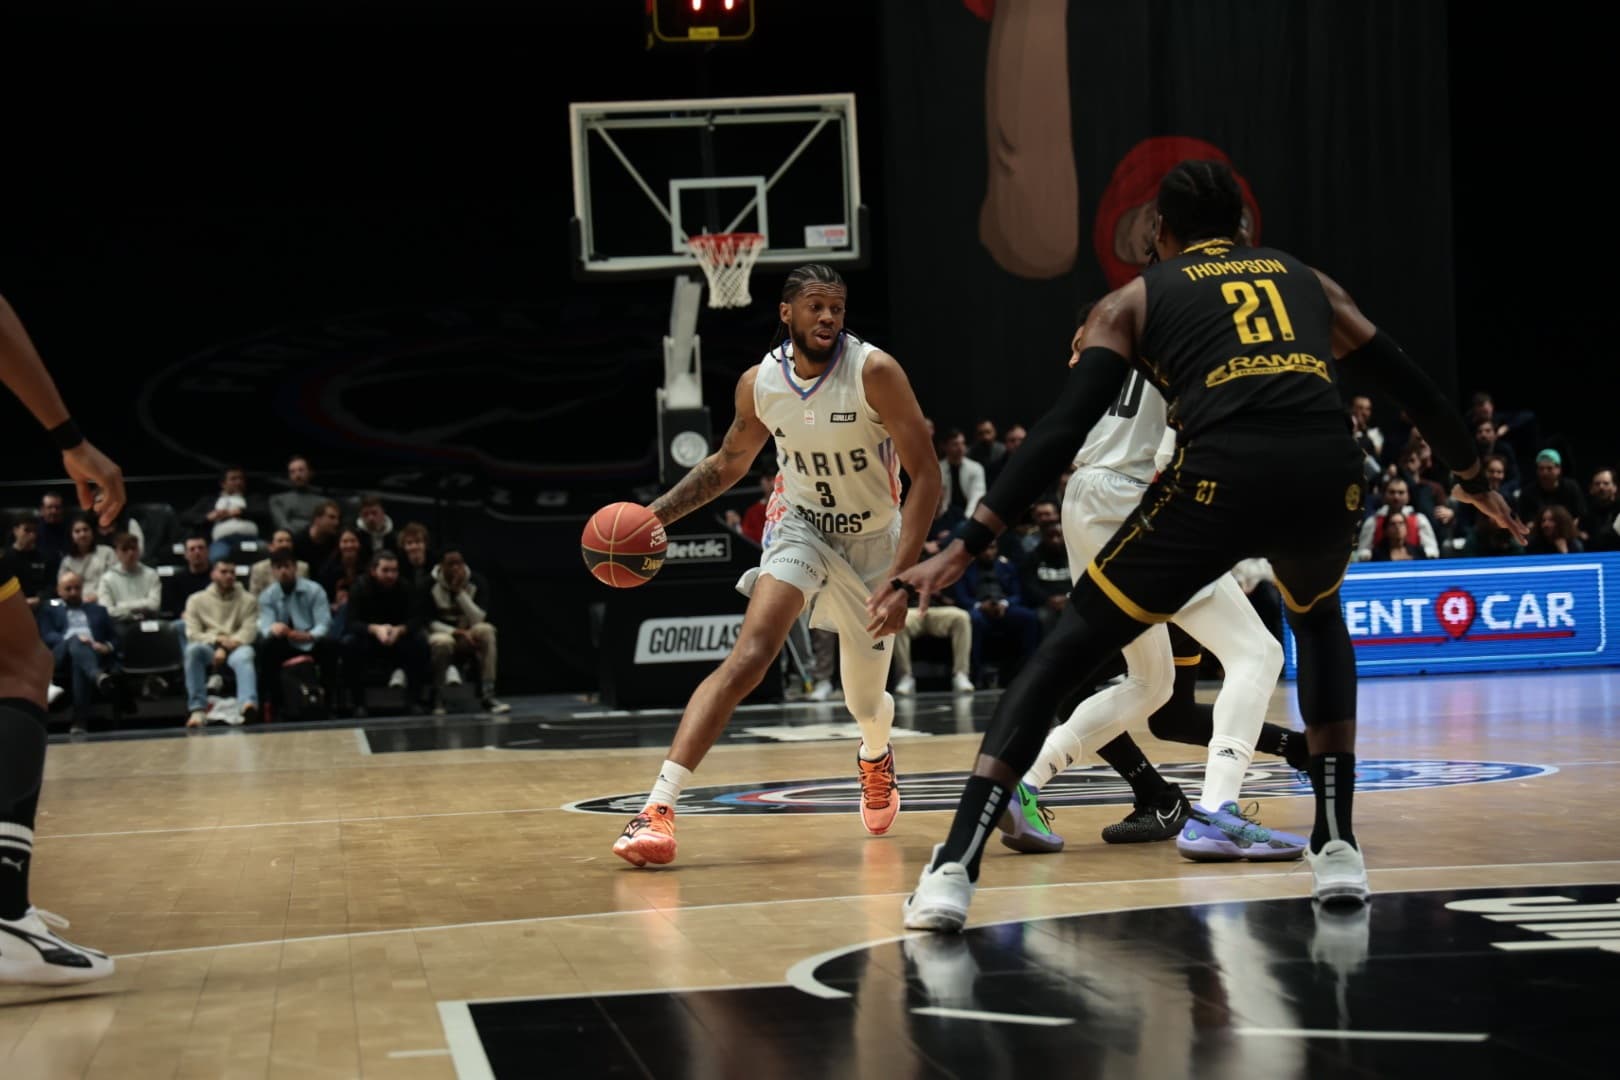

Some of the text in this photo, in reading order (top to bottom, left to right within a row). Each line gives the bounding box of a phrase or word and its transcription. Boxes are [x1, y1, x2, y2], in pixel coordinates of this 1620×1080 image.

[1181, 257, 1288, 283] THOMPSON
[1220, 278, 1297, 346] 21
[815, 481, 836, 508] 3
[1193, 479, 1219, 506] 21
[1341, 597, 1430, 636] ENT
[1480, 591, 1576, 630] CAR
